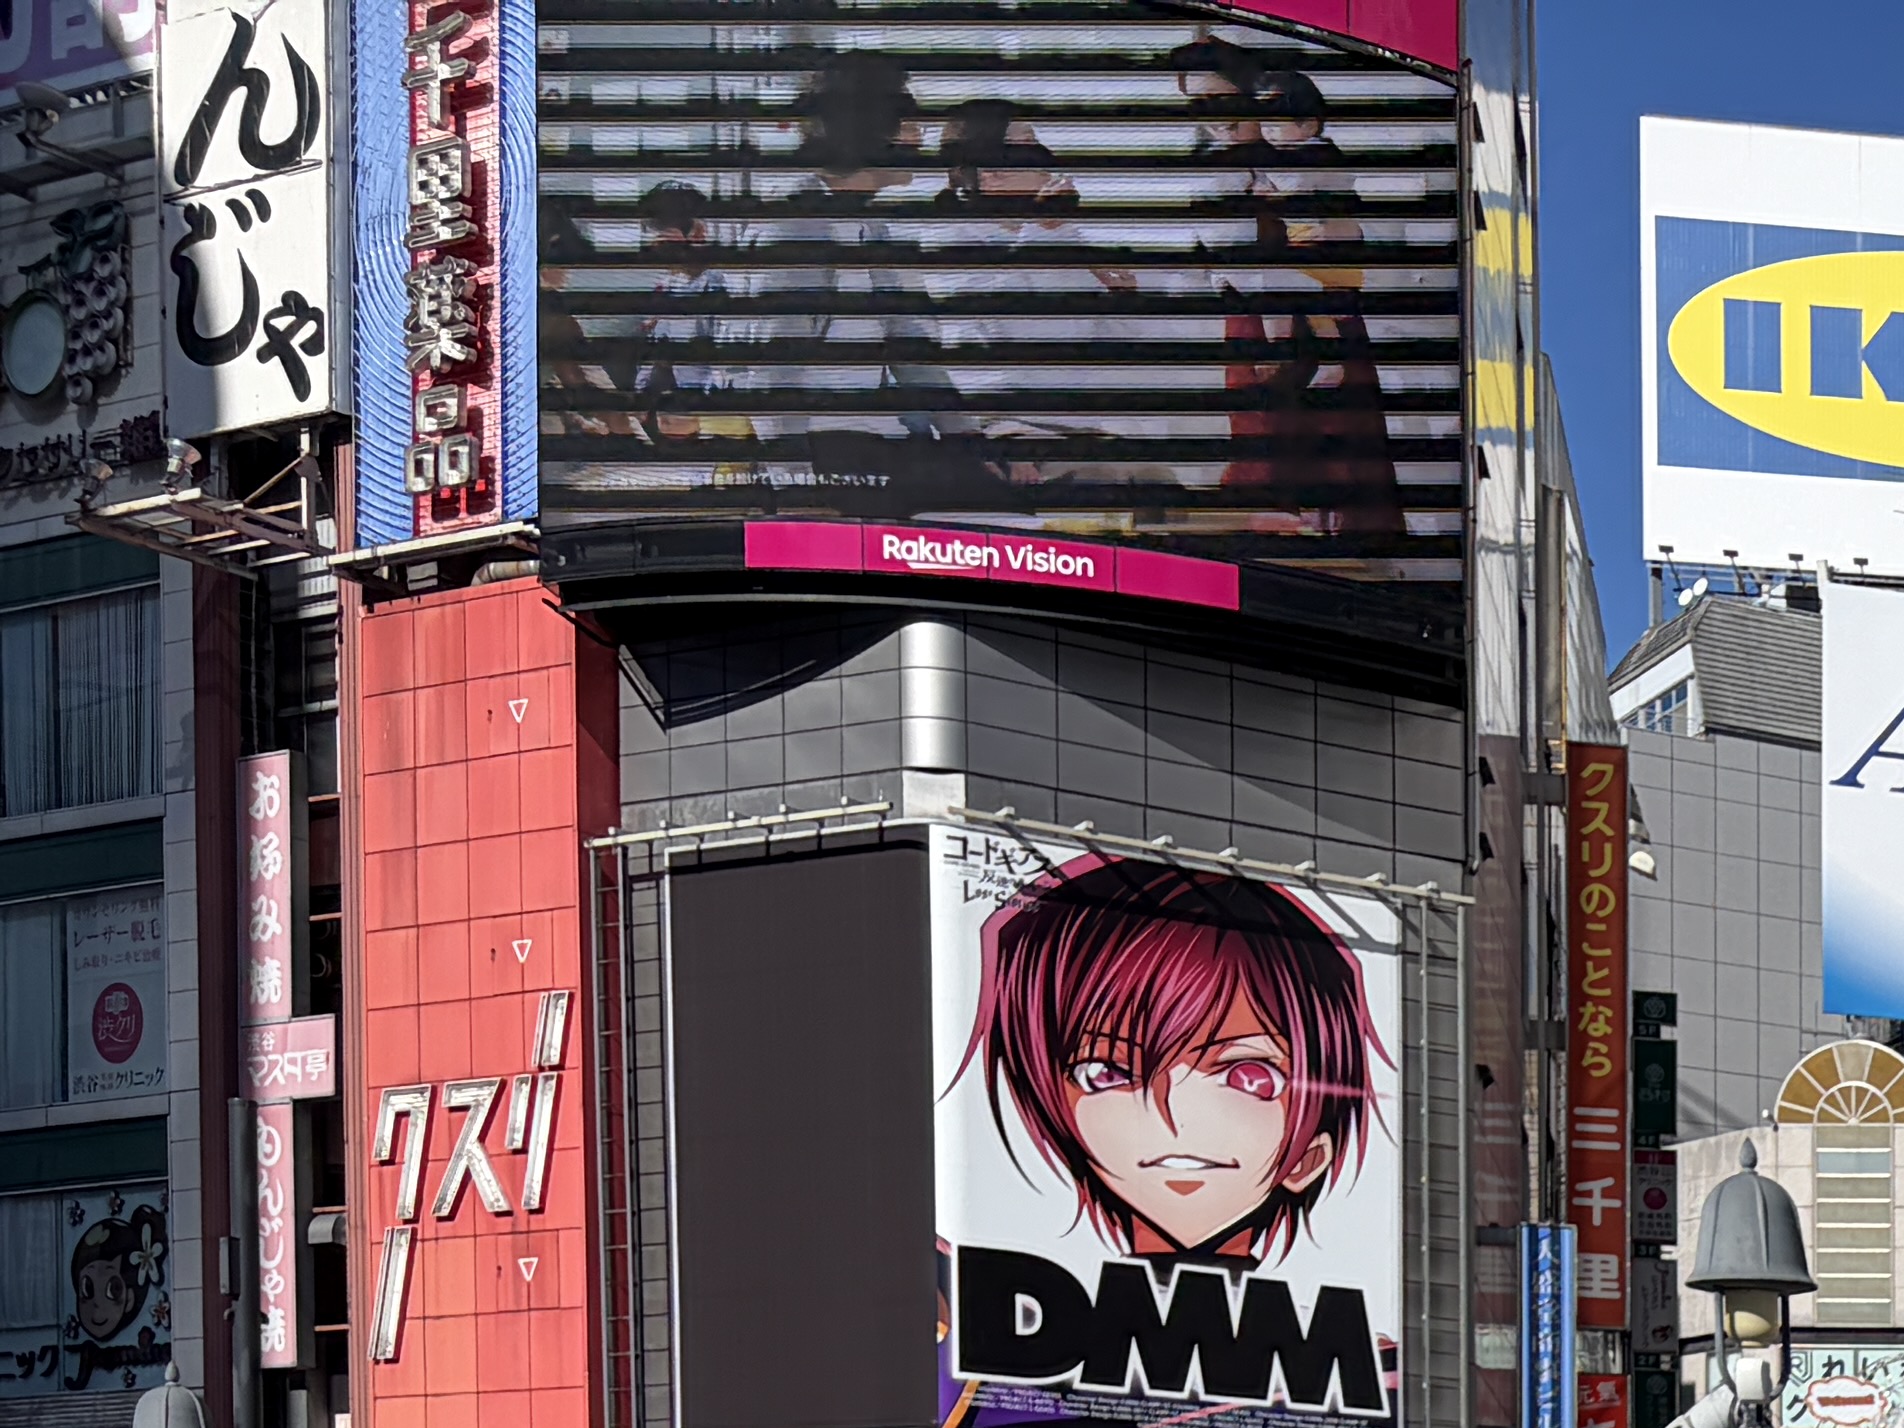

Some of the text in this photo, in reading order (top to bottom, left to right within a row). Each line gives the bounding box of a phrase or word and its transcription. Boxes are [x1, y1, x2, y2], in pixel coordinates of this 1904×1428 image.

[883, 533, 1095, 579] Rakuten Vision
[249, 770, 283, 1004] お好み焼
[1577, 761, 1618, 1078] クスリのことなら
[1572, 1106, 1622, 1299] 三千里
[958, 1245, 1382, 1410] DMM
